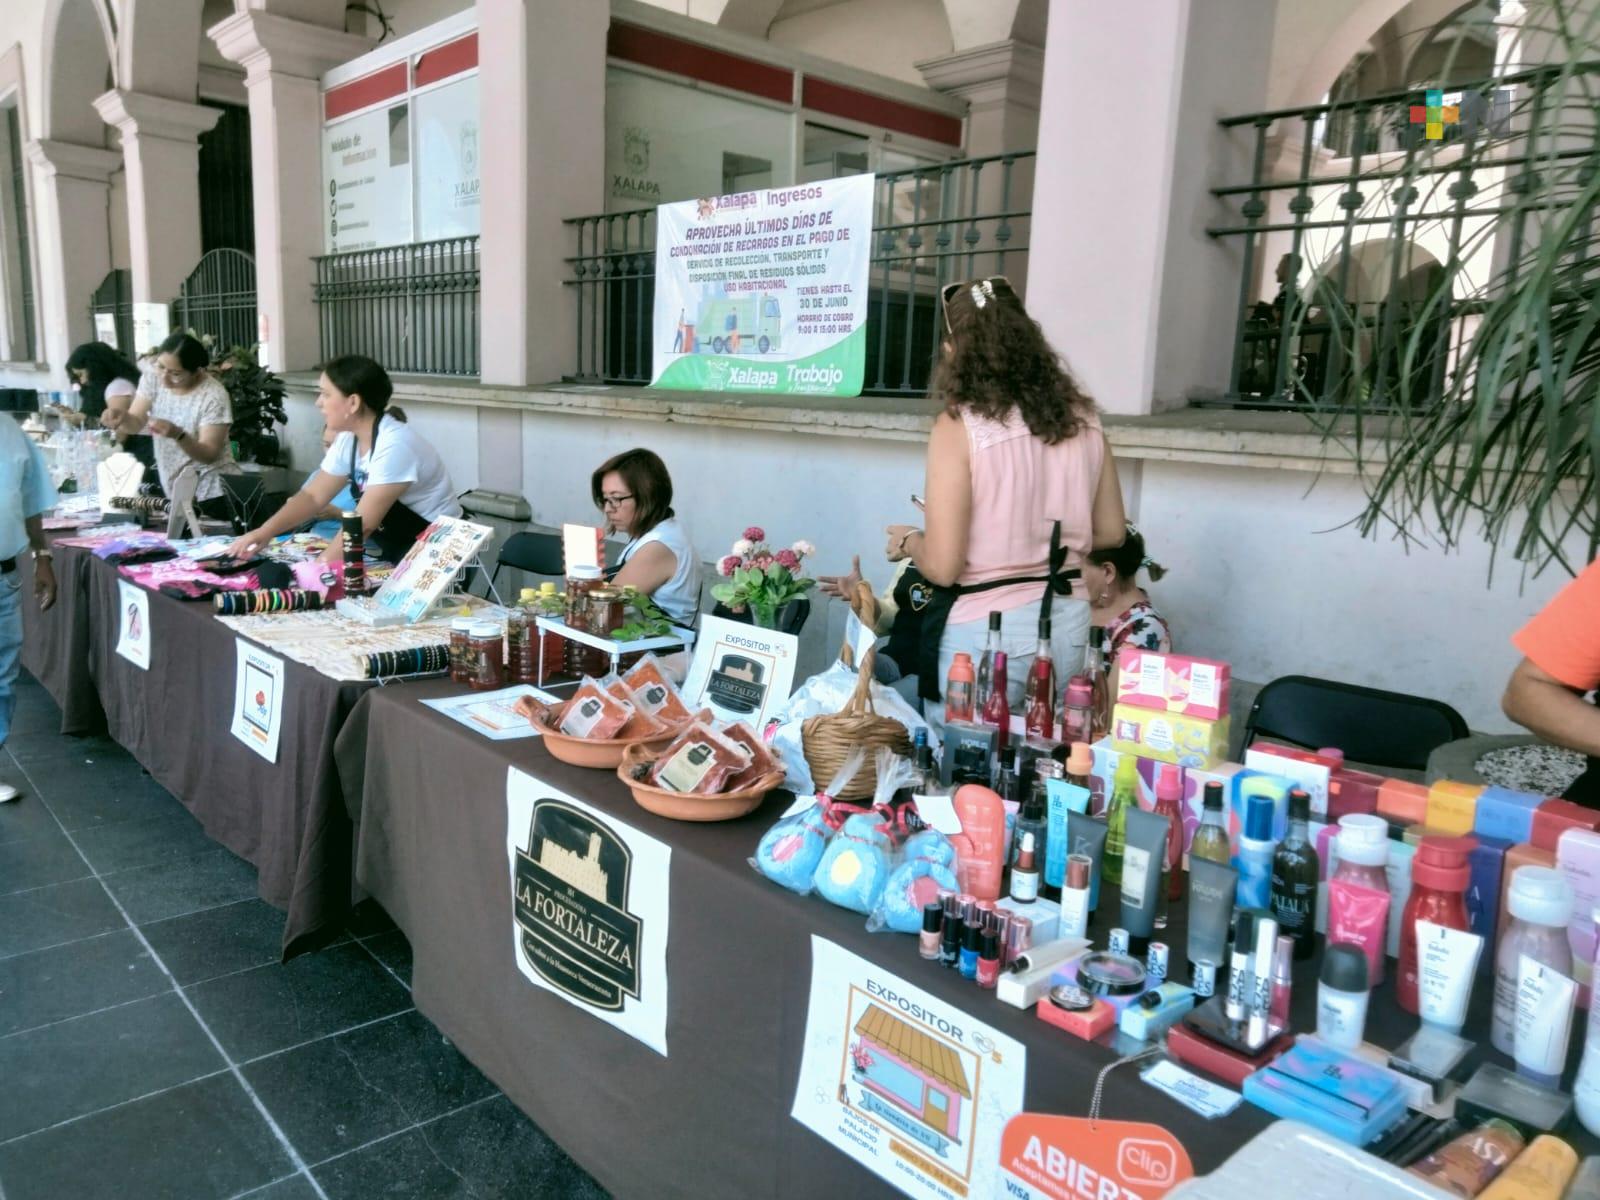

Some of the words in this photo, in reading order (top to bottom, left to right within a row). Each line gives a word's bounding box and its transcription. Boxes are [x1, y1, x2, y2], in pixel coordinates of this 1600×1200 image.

[454, 178, 480, 197] XALAP
[612, 174, 661, 194] XALAPA
[716, 191, 757, 210] Xalapa
[767, 186, 823, 207] Ingresos
[686, 223, 742, 241] APROVECHA
[745, 217, 789, 236] ÚLTIMOS
[792, 209, 816, 230] DÍAS
[818, 210, 833, 226] DE
[670, 239, 721, 257] CONDONACIÓN
[723, 241, 735, 253] DE
[736, 236, 779, 252] RECARGOS
[782, 235, 794, 248] EN
[796, 233, 807, 246] EL
[809, 230, 834, 244] PAGO
[837, 228, 850, 241] DE
[687, 258, 713, 270] SERVICIO
[715, 257, 723, 268] DE
[773, 248, 823, 263] TRANSPORTE
[824, 247, 830, 259] Y
[728, 268, 748, 280] FINAL
[749, 268, 758, 279] DE
[760, 266, 794, 278] RESIDUOS
[724, 282, 736, 292] USO
[738, 279, 788, 292] HABITACIONAL
[797, 286, 819, 296] TIENES
[821, 285, 842, 295] HASTA
[843, 283, 853, 293] EL
[800, 299, 811, 309] 30
[812, 298, 823, 308] DE
[825, 296, 848, 307] JUNIO
[797, 313, 823, 323] HORARIO
[824, 313, 832, 322] DE
[833, 312, 854, 322] COBRO
[728, 366, 778, 389] Xalapa
[785, 362, 844, 387] Trabajo
[725, 634, 771, 652] EXPOSITOR
[720, 681, 761, 699] FORTALEZA
[515, 878, 532, 907] LA
[534, 891, 634, 969] FORTALEZA
[866, 978, 964, 1042] EXPOSITOR
[842, 1106, 869, 1128] BAJOS
[869, 1123, 880, 1135] DE
[843, 1117, 878, 1144] PALACIO
[838, 1125, 880, 1157] MUNICIPAL
[1023, 1135, 1143, 1200] ABIERT
[1125, 1146, 1168, 1180] Clip
[1005, 1179, 1030, 1200] VISA
